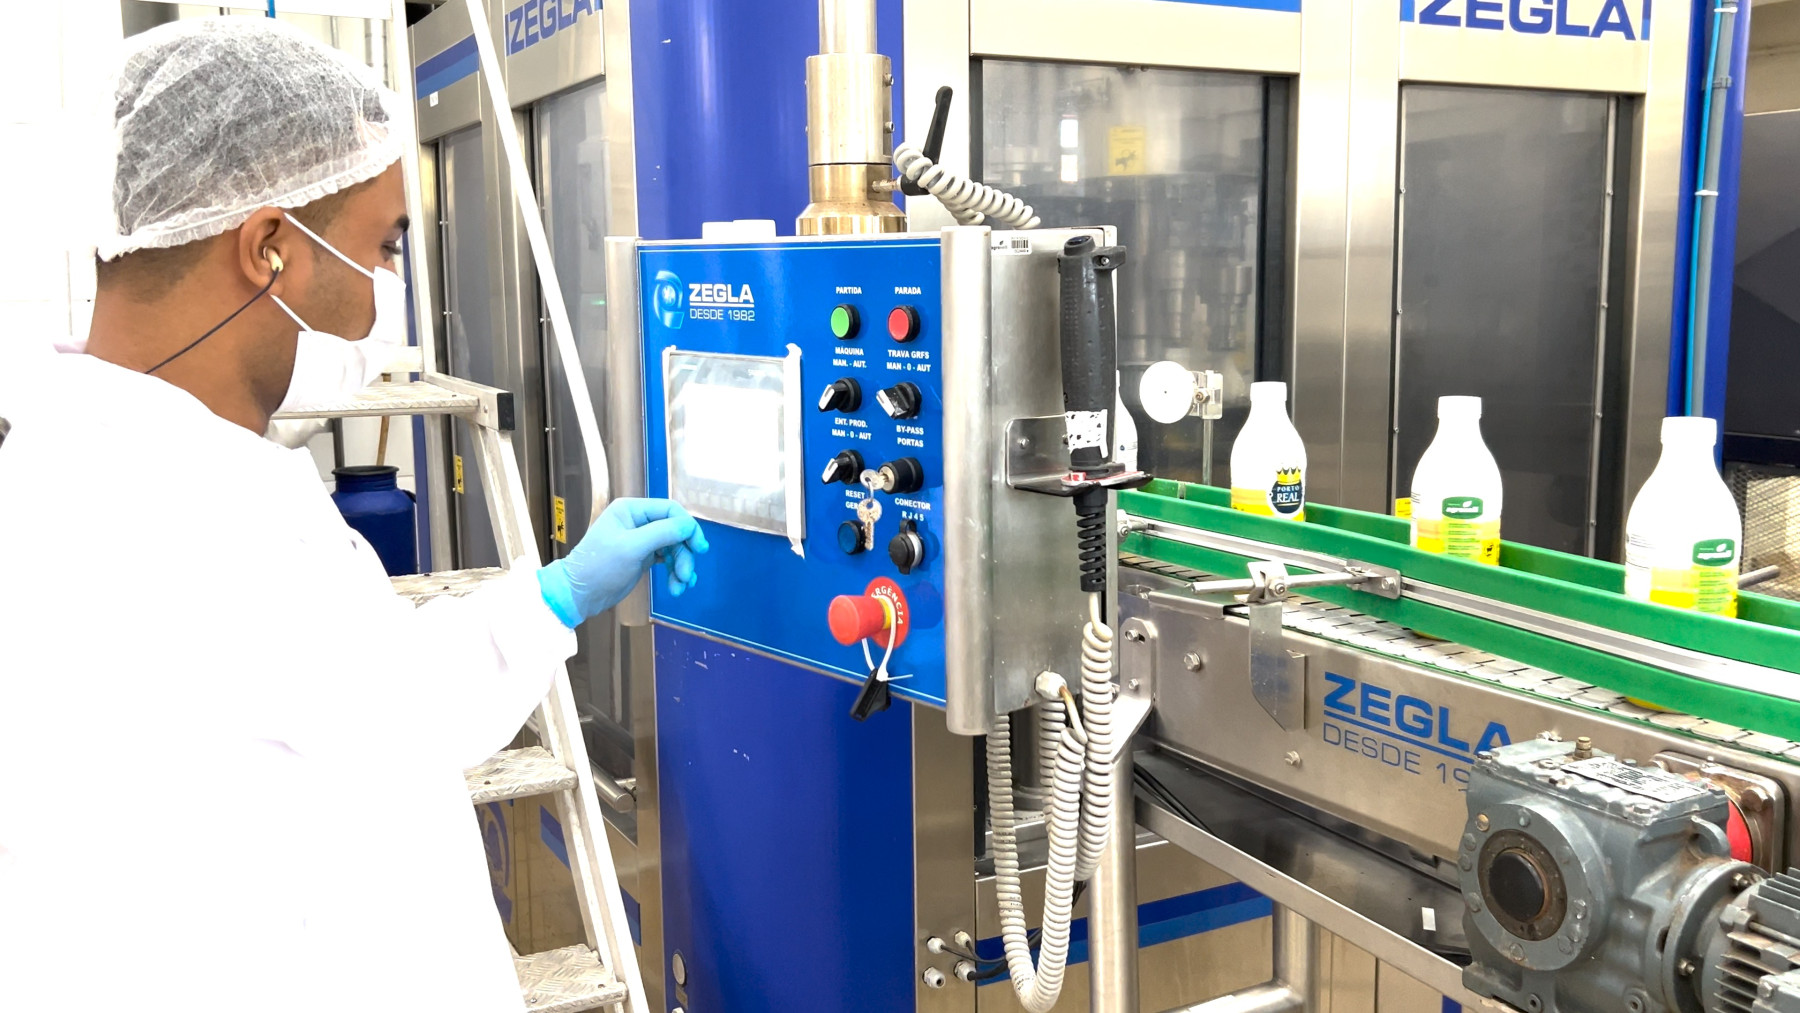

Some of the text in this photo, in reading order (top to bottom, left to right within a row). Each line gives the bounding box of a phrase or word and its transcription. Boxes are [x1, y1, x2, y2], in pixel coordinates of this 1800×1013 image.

[1419, 0, 1636, 40] ZEGLA
[689, 284, 754, 303] ZEGLA
[690, 309, 754, 321] DESDE 1982
[835, 347, 864, 355] MÁQUINA
[888, 350, 929, 359] TRAVA GRFS
[887, 362, 901, 370] MAN
[835, 418, 867, 427] ENT. PROD.
[832, 429, 845, 437] MAN
[859, 432, 871, 440] AUT
[896, 425, 924, 435] BY-PASS
[897, 437, 923, 447] PORTAS
[846, 490, 865, 499] RESET
[1276, 492, 1300, 503] REAL
[845, 502, 859, 510] GER
[895, 498, 931, 510] CONECTOR
[1324, 672, 1512, 756] ZEGLA
[1323, 722, 1470, 784] DESDE 19
